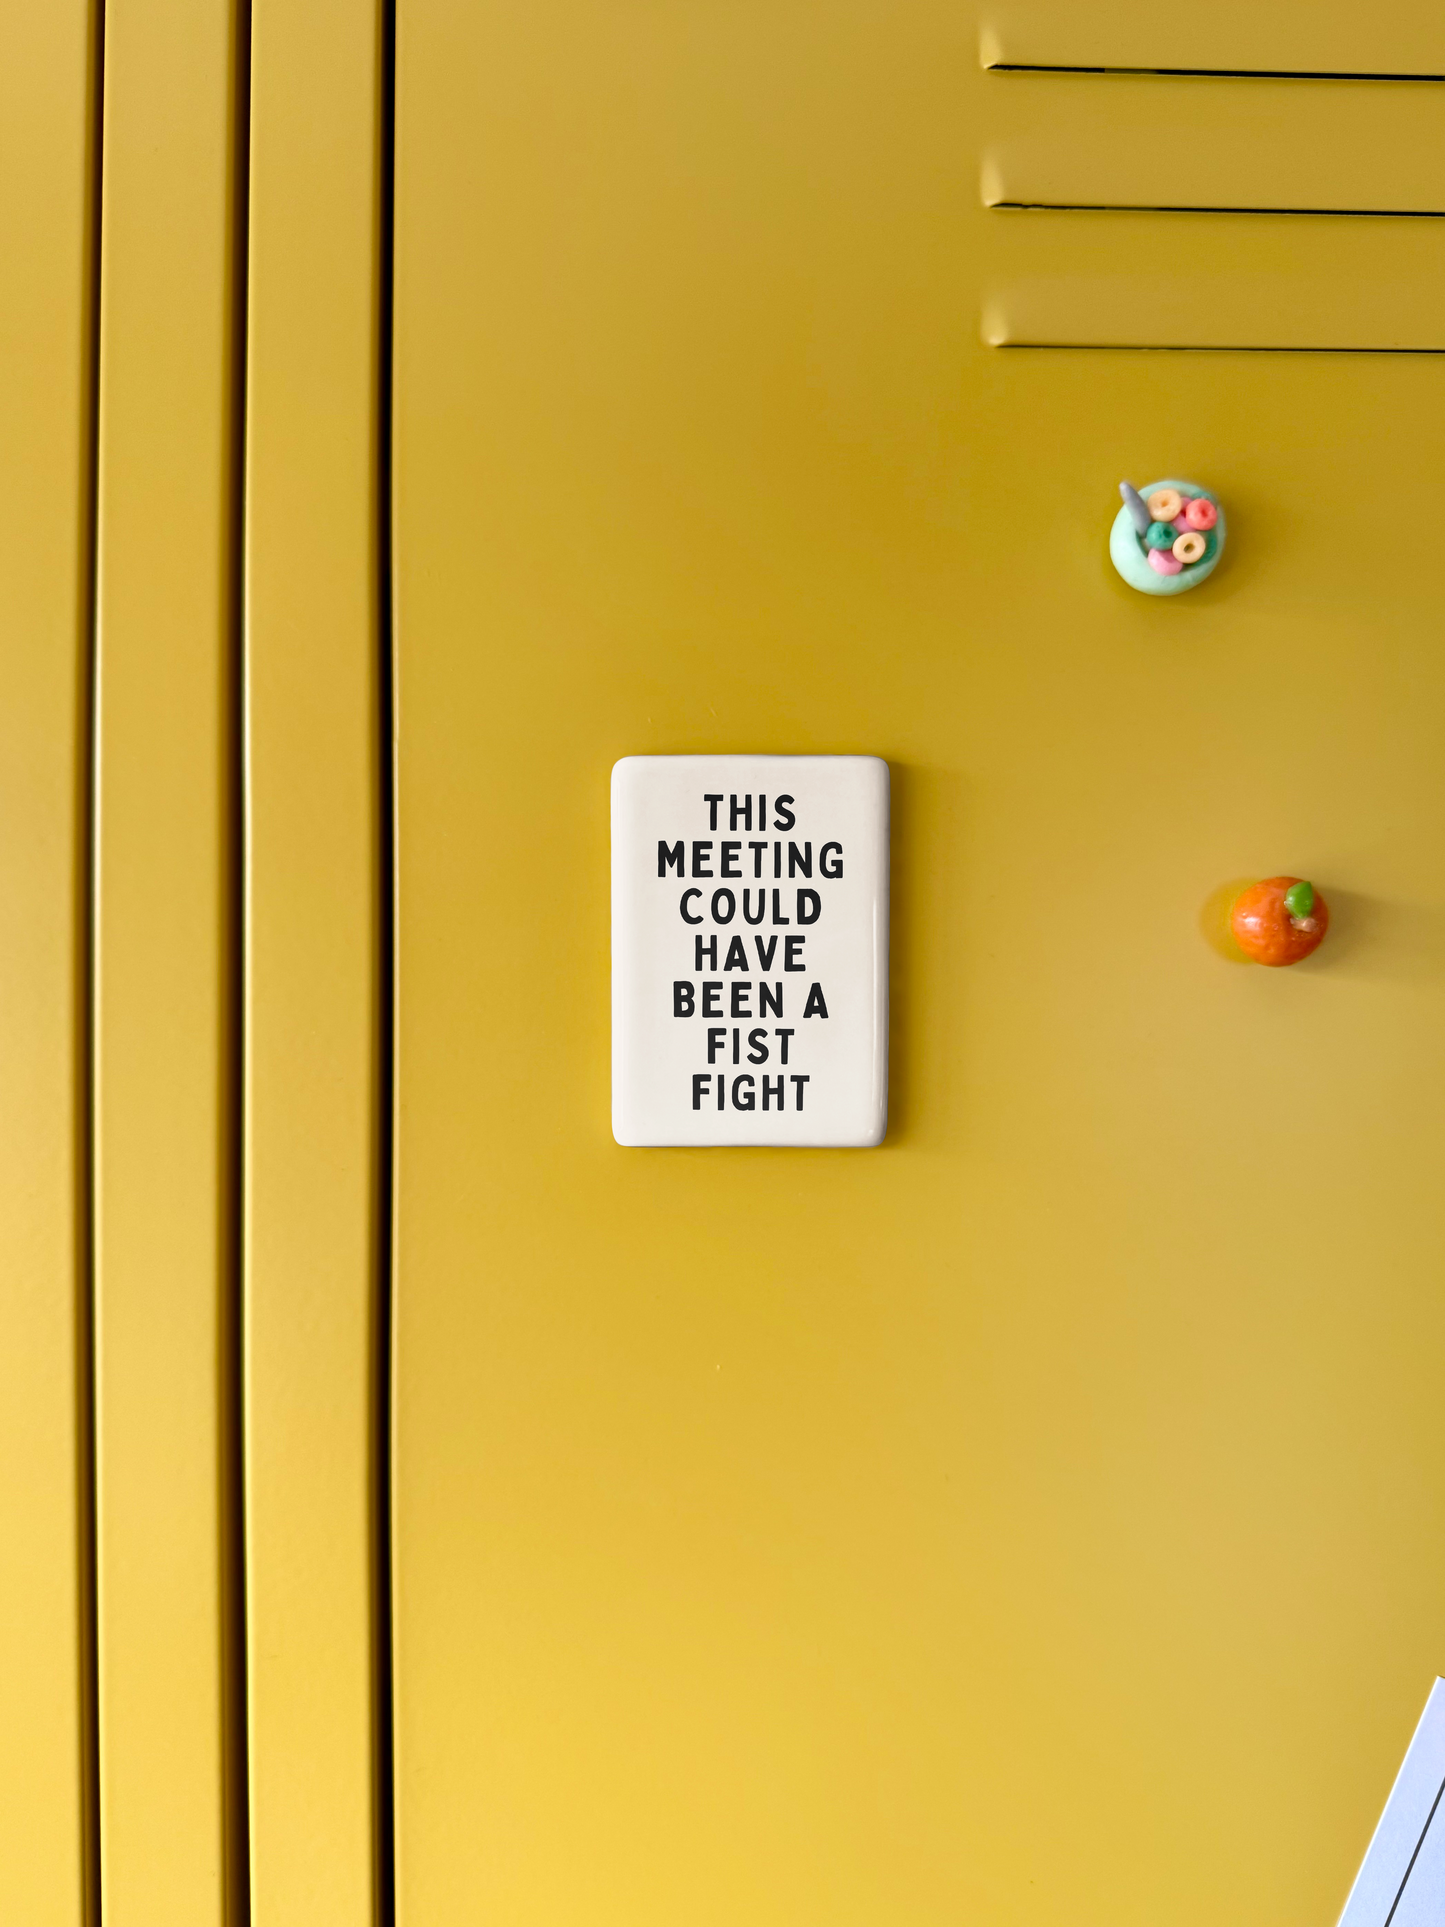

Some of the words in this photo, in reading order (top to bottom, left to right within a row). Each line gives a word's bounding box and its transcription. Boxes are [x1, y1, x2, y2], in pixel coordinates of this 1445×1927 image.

[704, 794, 795, 831] THIS
[658, 841, 843, 879] MEETING
[680, 888, 821, 925] COULD
[695, 935, 805, 972] HAVE
[674, 981, 783, 1018] BEEN
[803, 983, 828, 1018] A
[708, 1028, 794, 1064] FIST
[693, 1074, 809, 1111] FIGHT
